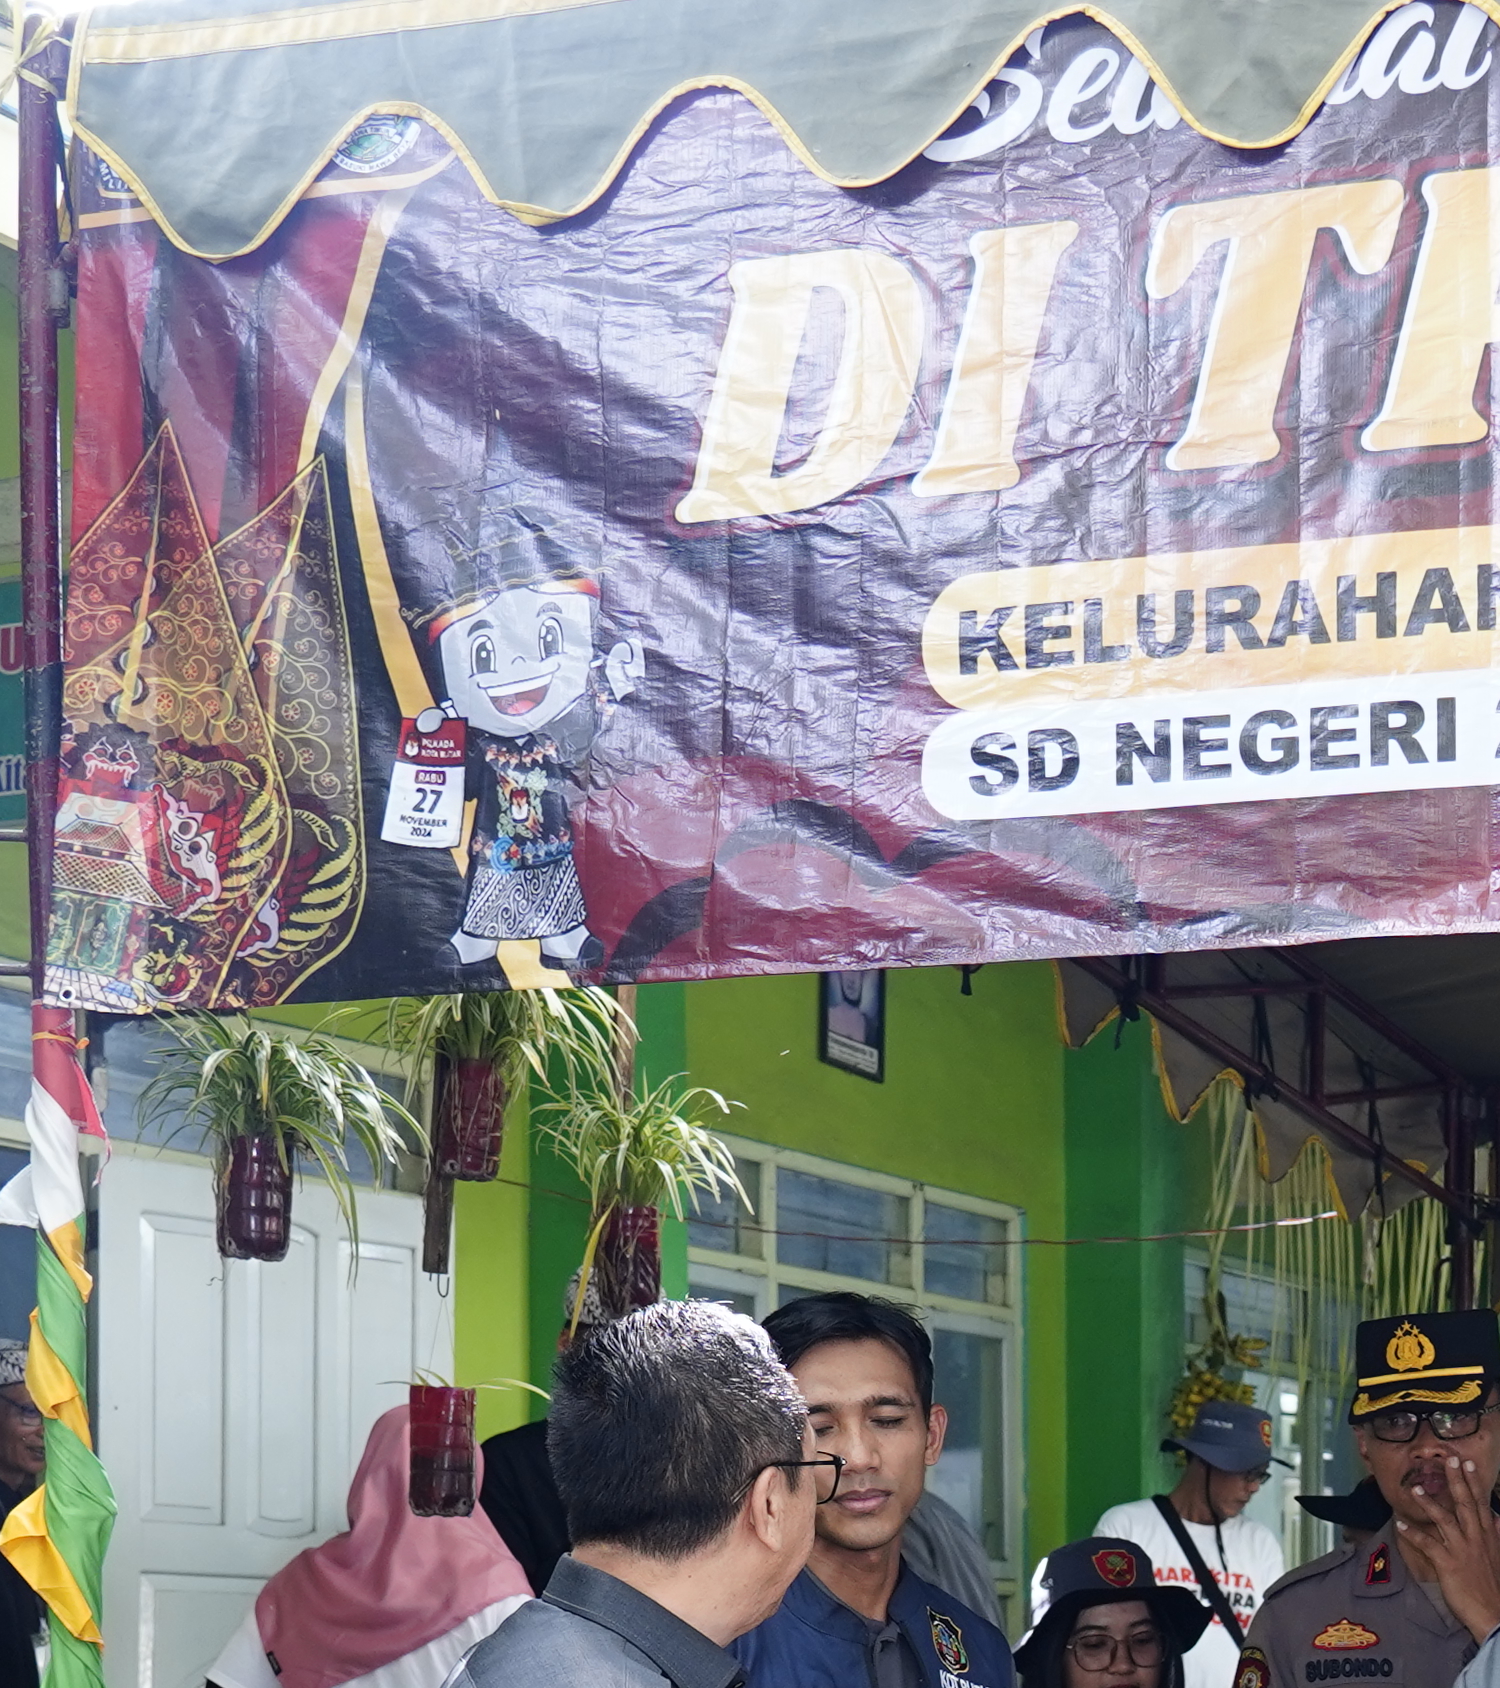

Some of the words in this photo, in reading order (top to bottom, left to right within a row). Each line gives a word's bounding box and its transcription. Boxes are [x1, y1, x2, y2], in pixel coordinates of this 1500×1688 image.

[675, 218, 1081, 526] DI
[966, 721, 1082, 796] SD
[1112, 696, 1461, 788] NEGERI
[418, 772, 444, 784] RABU
[412, 787, 443, 814] 27
[399, 814, 448, 828] NOVEMBER
[410, 826, 432, 838] 2024
[1305, 1657, 1394, 1683] SUBONDO
